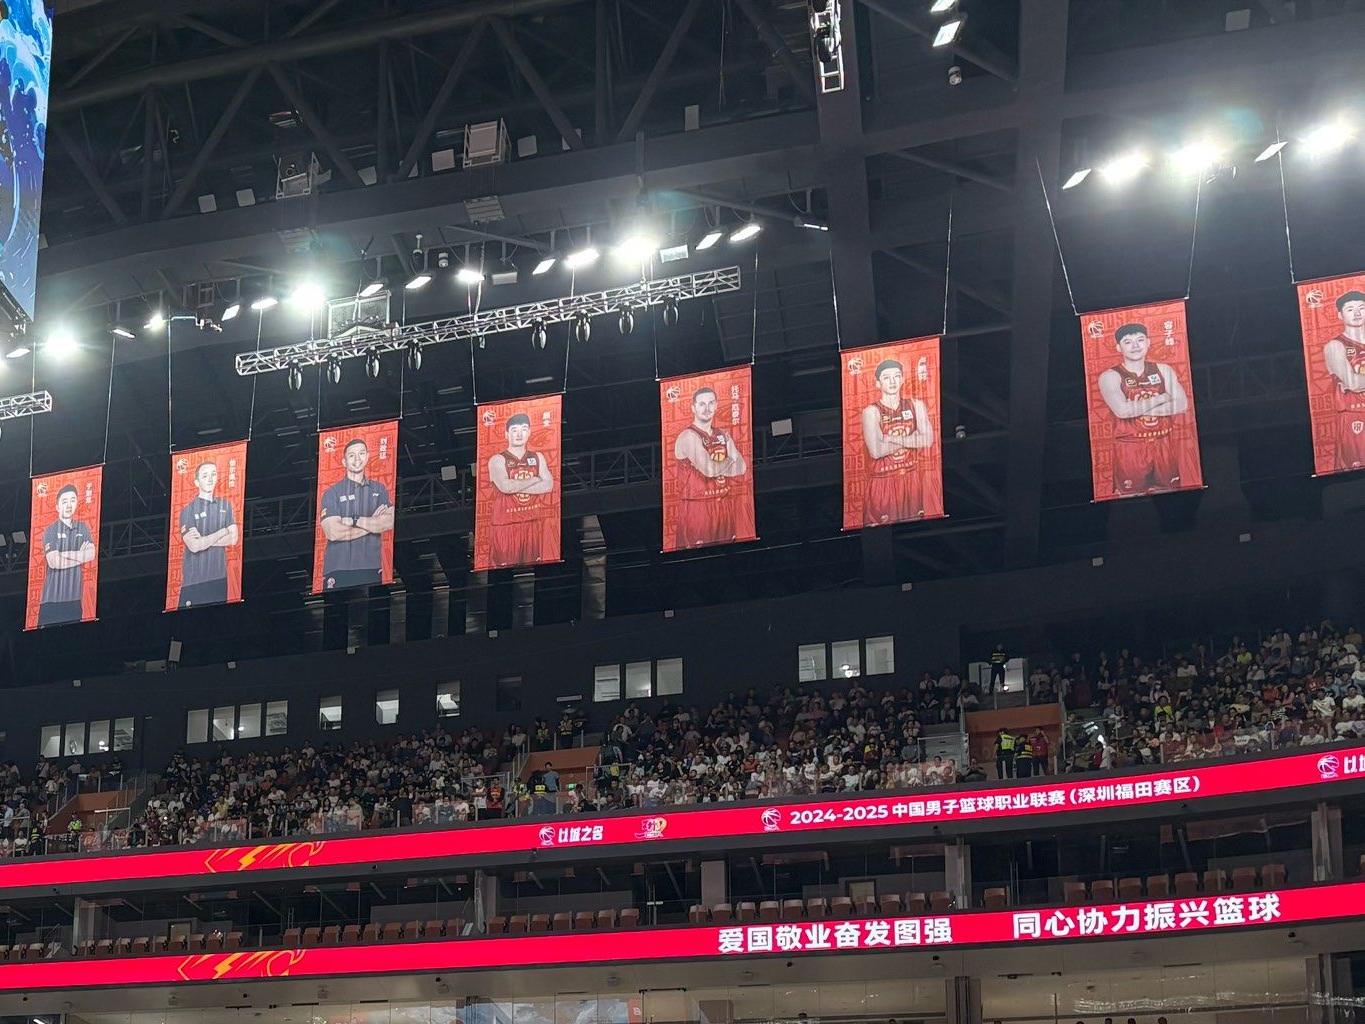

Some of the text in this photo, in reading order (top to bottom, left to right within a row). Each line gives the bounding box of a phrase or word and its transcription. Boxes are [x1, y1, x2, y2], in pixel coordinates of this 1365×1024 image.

[790, 804, 889, 826] 2024-2025
[718, 893, 1282, 954] 爱国敬业奋发图强 同心协力振兴篮球
